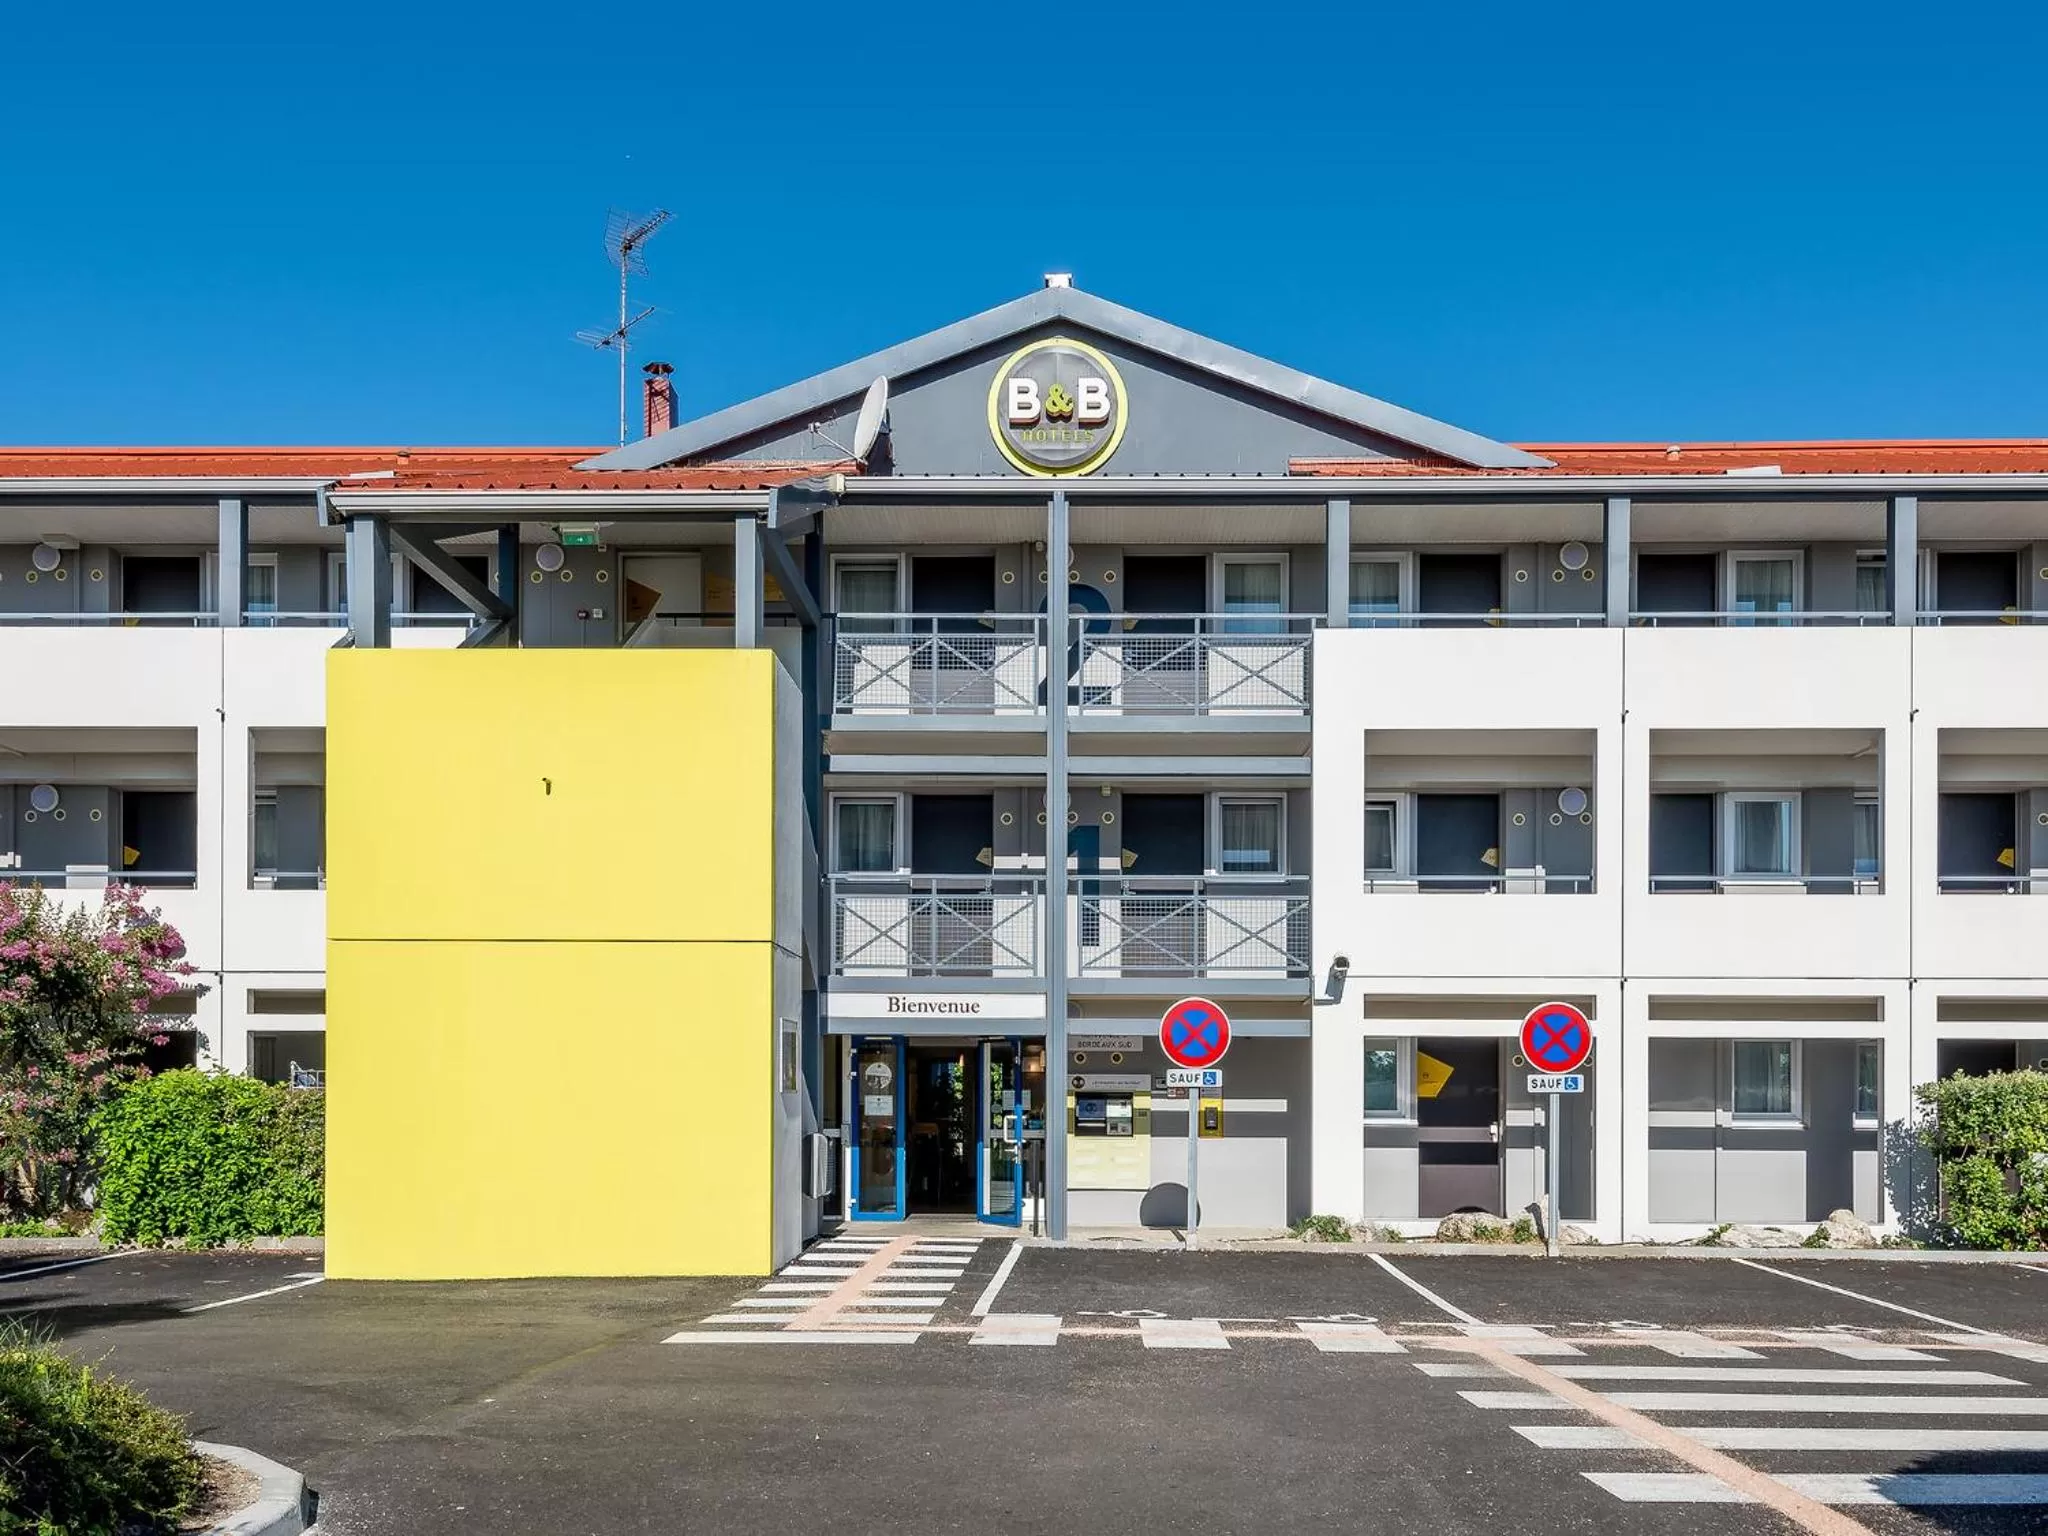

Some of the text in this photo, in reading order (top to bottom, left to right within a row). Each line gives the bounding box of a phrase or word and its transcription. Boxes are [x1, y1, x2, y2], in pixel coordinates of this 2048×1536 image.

[1008, 377, 1111, 422] B&B
[1021, 430, 1095, 442] HOTELS
[1038, 583, 1113, 707] 2
[887, 996, 981, 1014] Bienvenue
[1078, 1040, 1116, 1049] BORDEAUX
[1169, 1073, 1201, 1084] SAUF
[1531, 1078, 1563, 1089] SAUF
